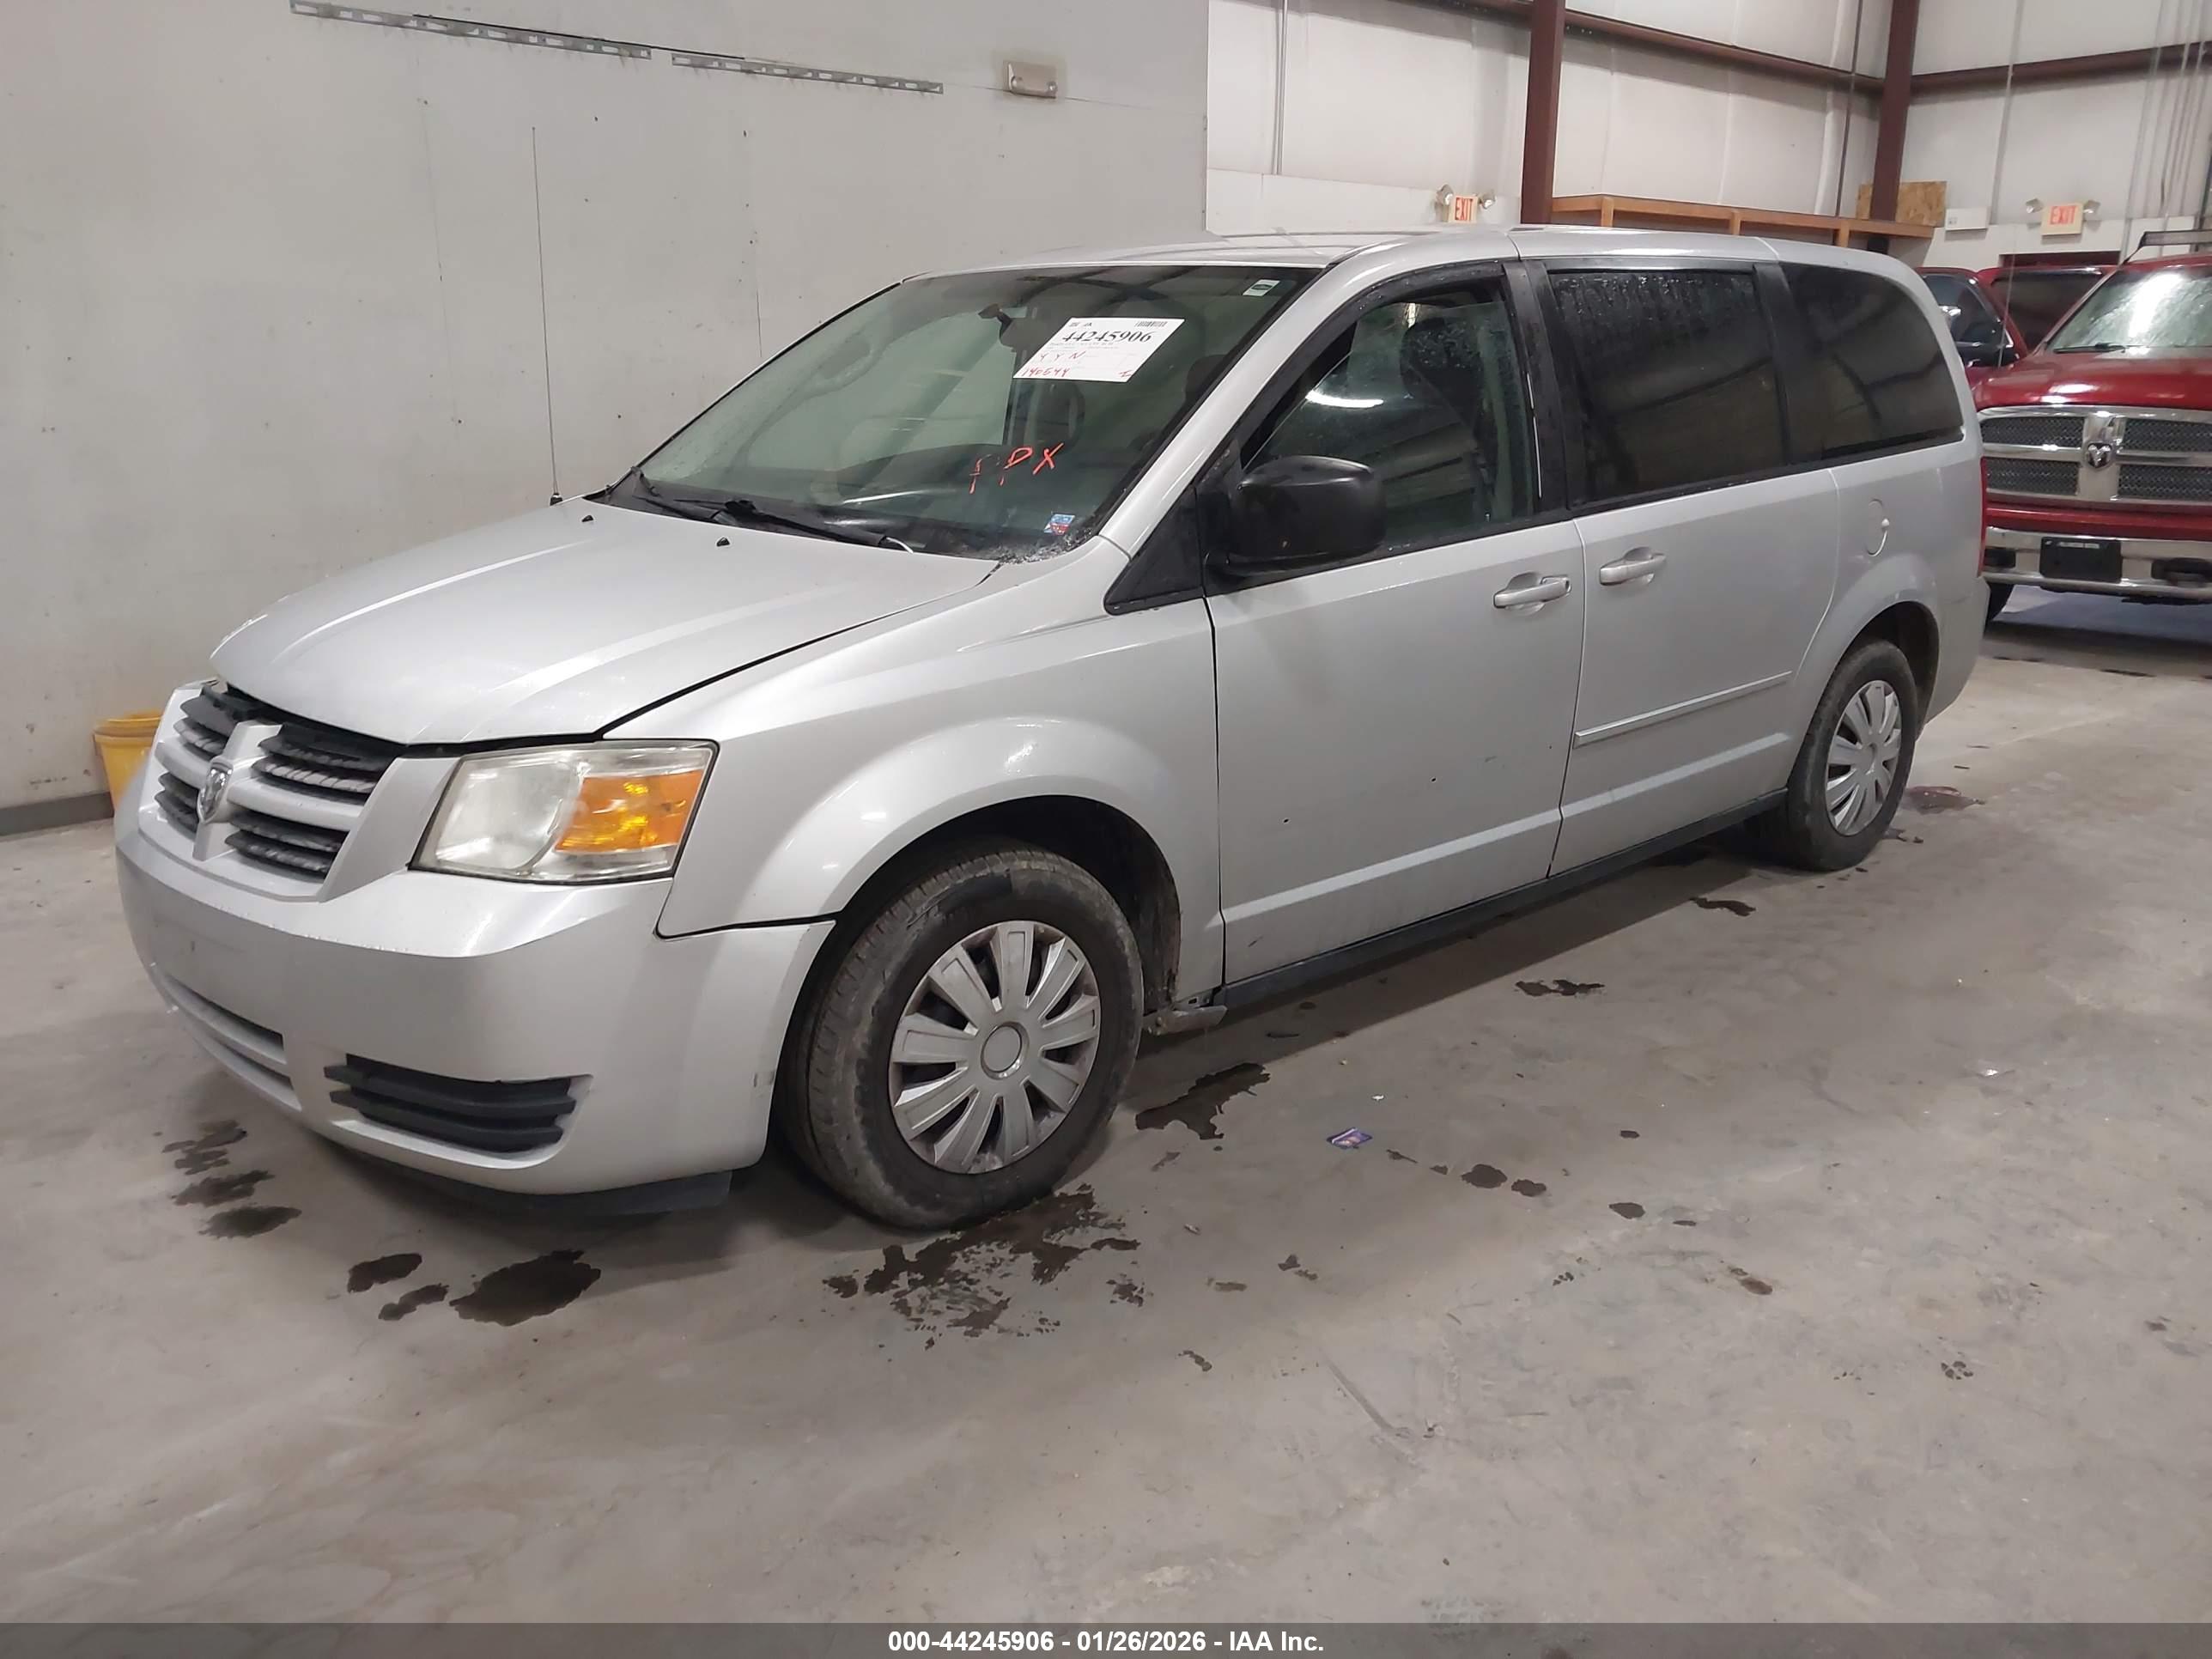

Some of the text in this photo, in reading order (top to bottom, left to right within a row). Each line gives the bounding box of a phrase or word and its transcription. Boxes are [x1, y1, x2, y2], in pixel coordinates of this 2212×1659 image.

[1454, 196, 1474, 221] EXIT
[2049, 204, 2076, 225] EXIT
[1062, 331, 1156, 343] 44245906
